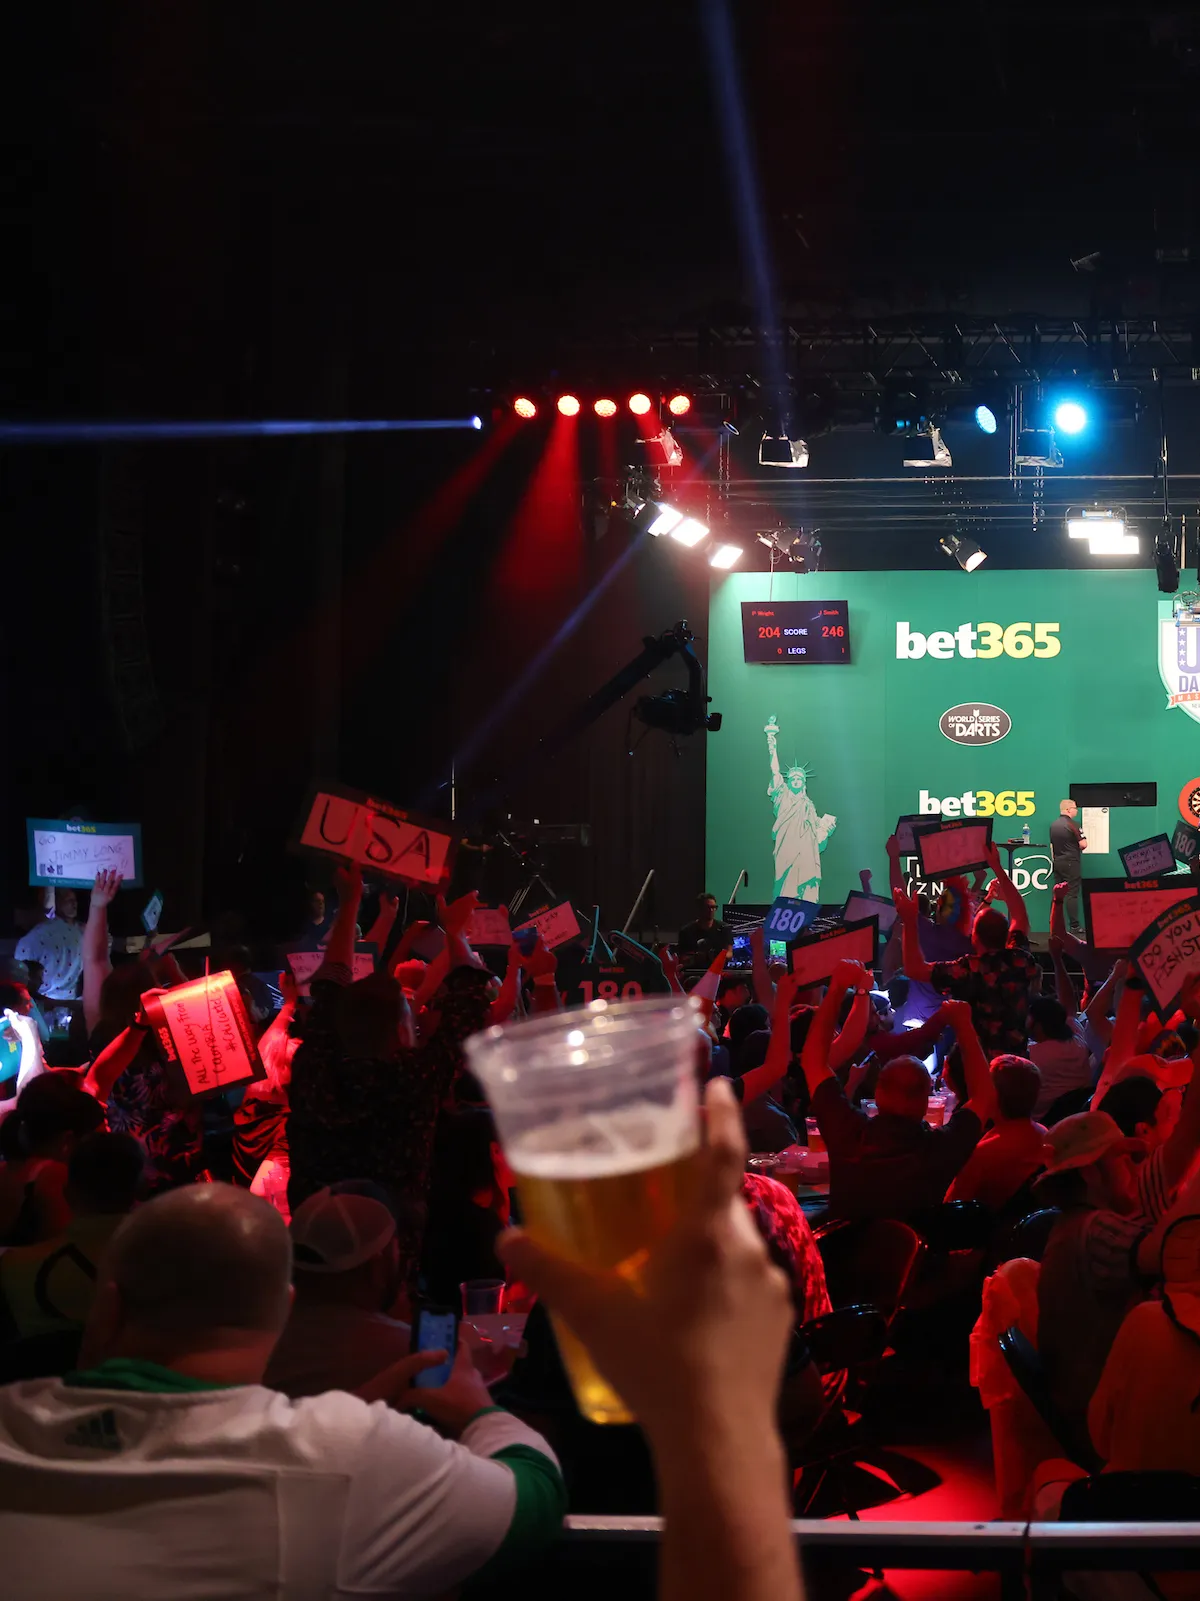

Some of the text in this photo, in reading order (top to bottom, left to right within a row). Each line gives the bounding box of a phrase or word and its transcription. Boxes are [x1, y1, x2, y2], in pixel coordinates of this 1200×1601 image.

[758, 626, 844, 638] 204 SCORE 246
[896, 621, 1061, 659] bet365
[955, 723, 1001, 736] DARTS
[919, 790, 1036, 817] bet365
[319, 798, 431, 876] USA
[1174, 832, 1196, 857] 180
[49, 848, 89, 864] JIMMY
[769, 908, 806, 933] 180
[1142, 944, 1162, 968] DO
[158, 1026, 177, 1062] bet365
